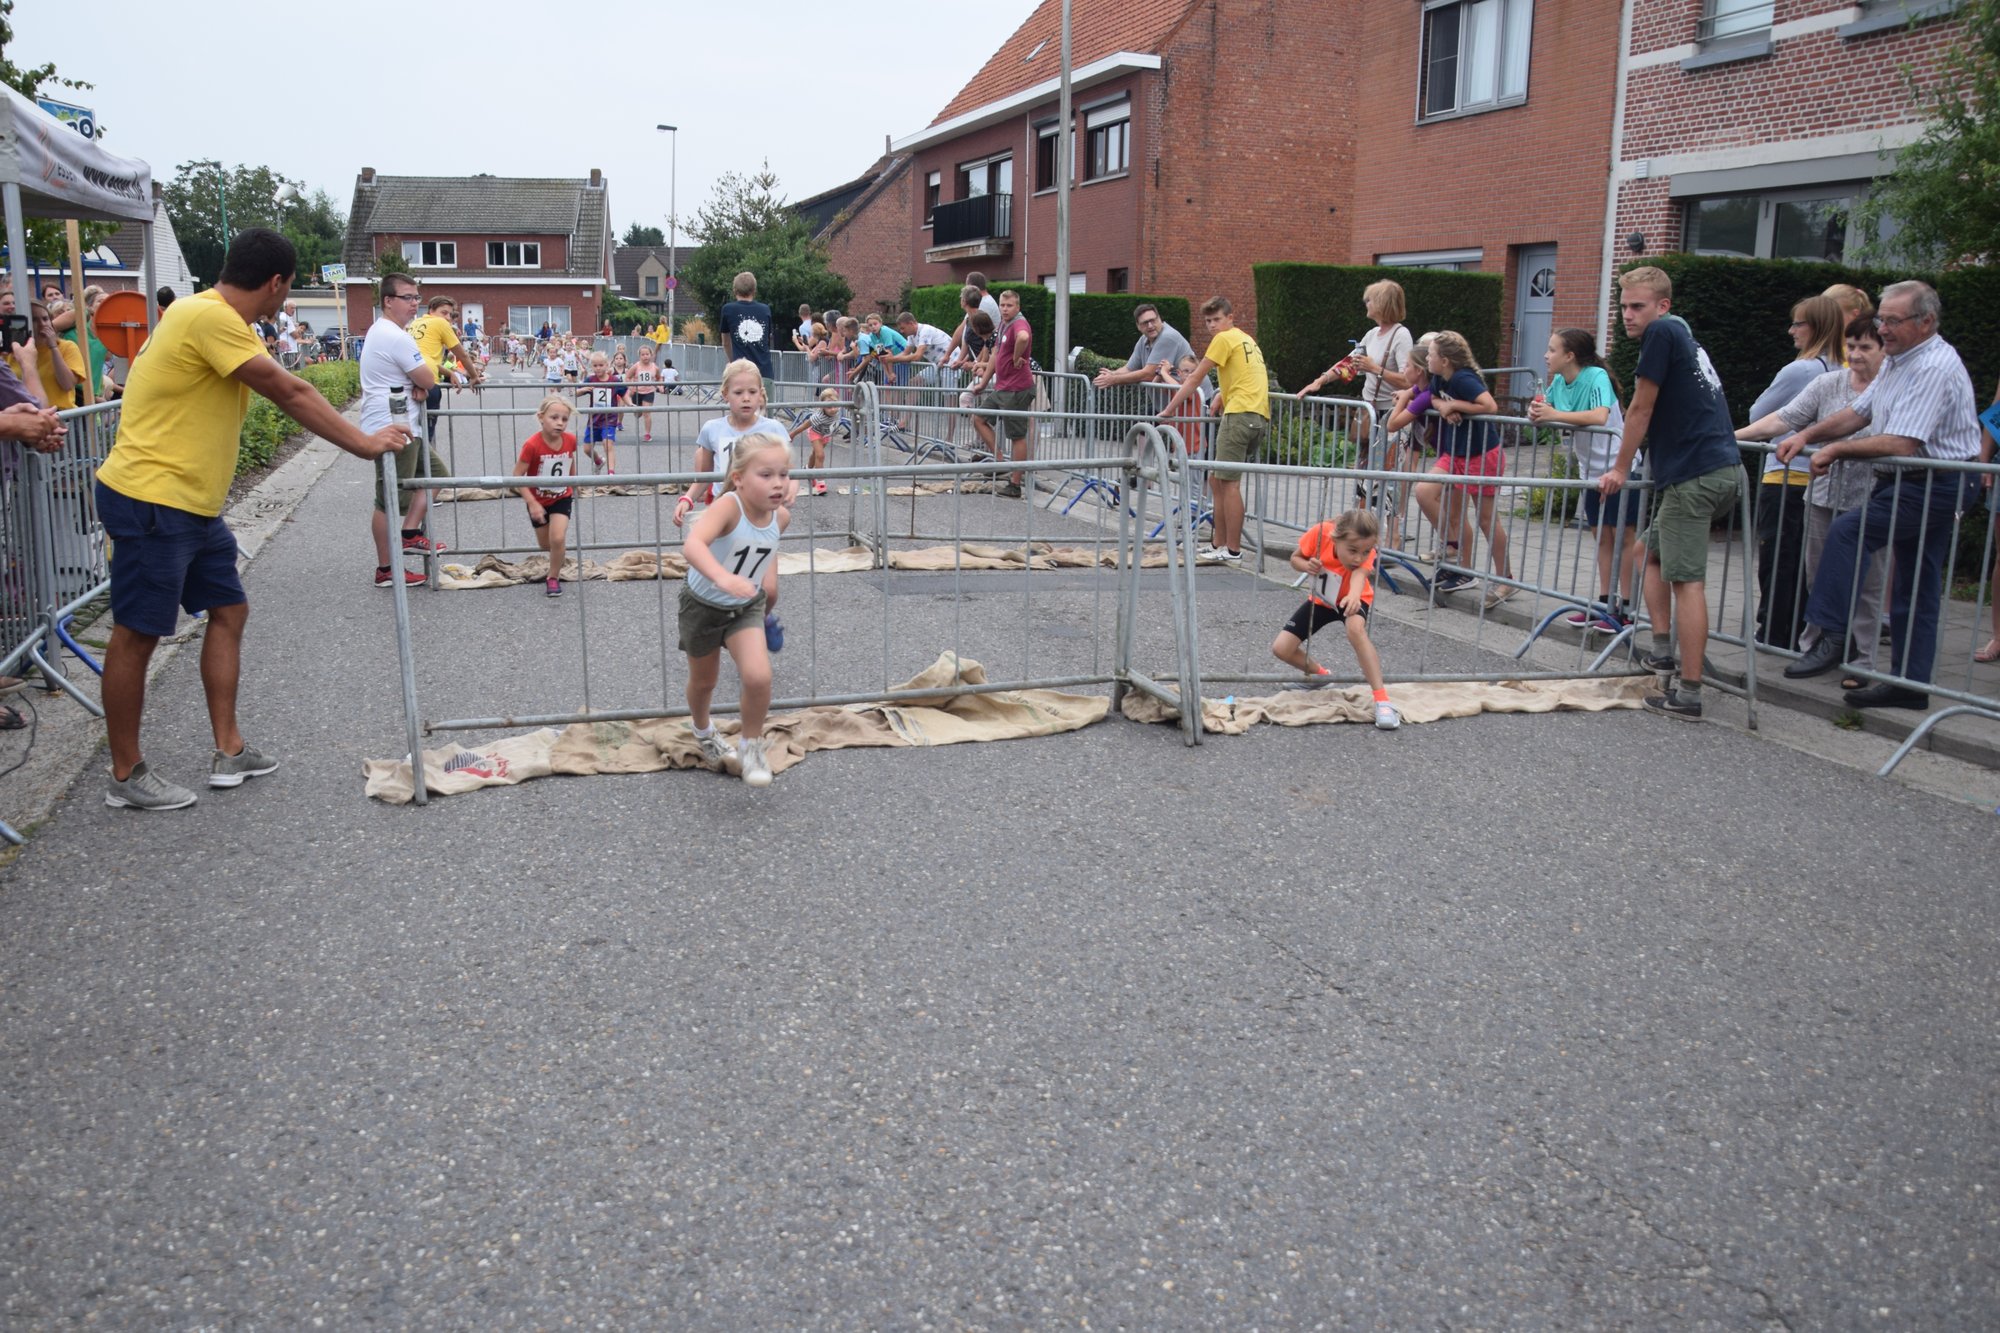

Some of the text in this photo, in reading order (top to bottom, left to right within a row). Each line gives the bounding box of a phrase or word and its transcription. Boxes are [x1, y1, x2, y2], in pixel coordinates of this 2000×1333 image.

[324, 267, 345, 278] START
[640, 372, 650, 382] 18
[598, 390, 607, 402] 2
[550, 461, 563, 477] 6
[733, 544, 772, 579] 17
